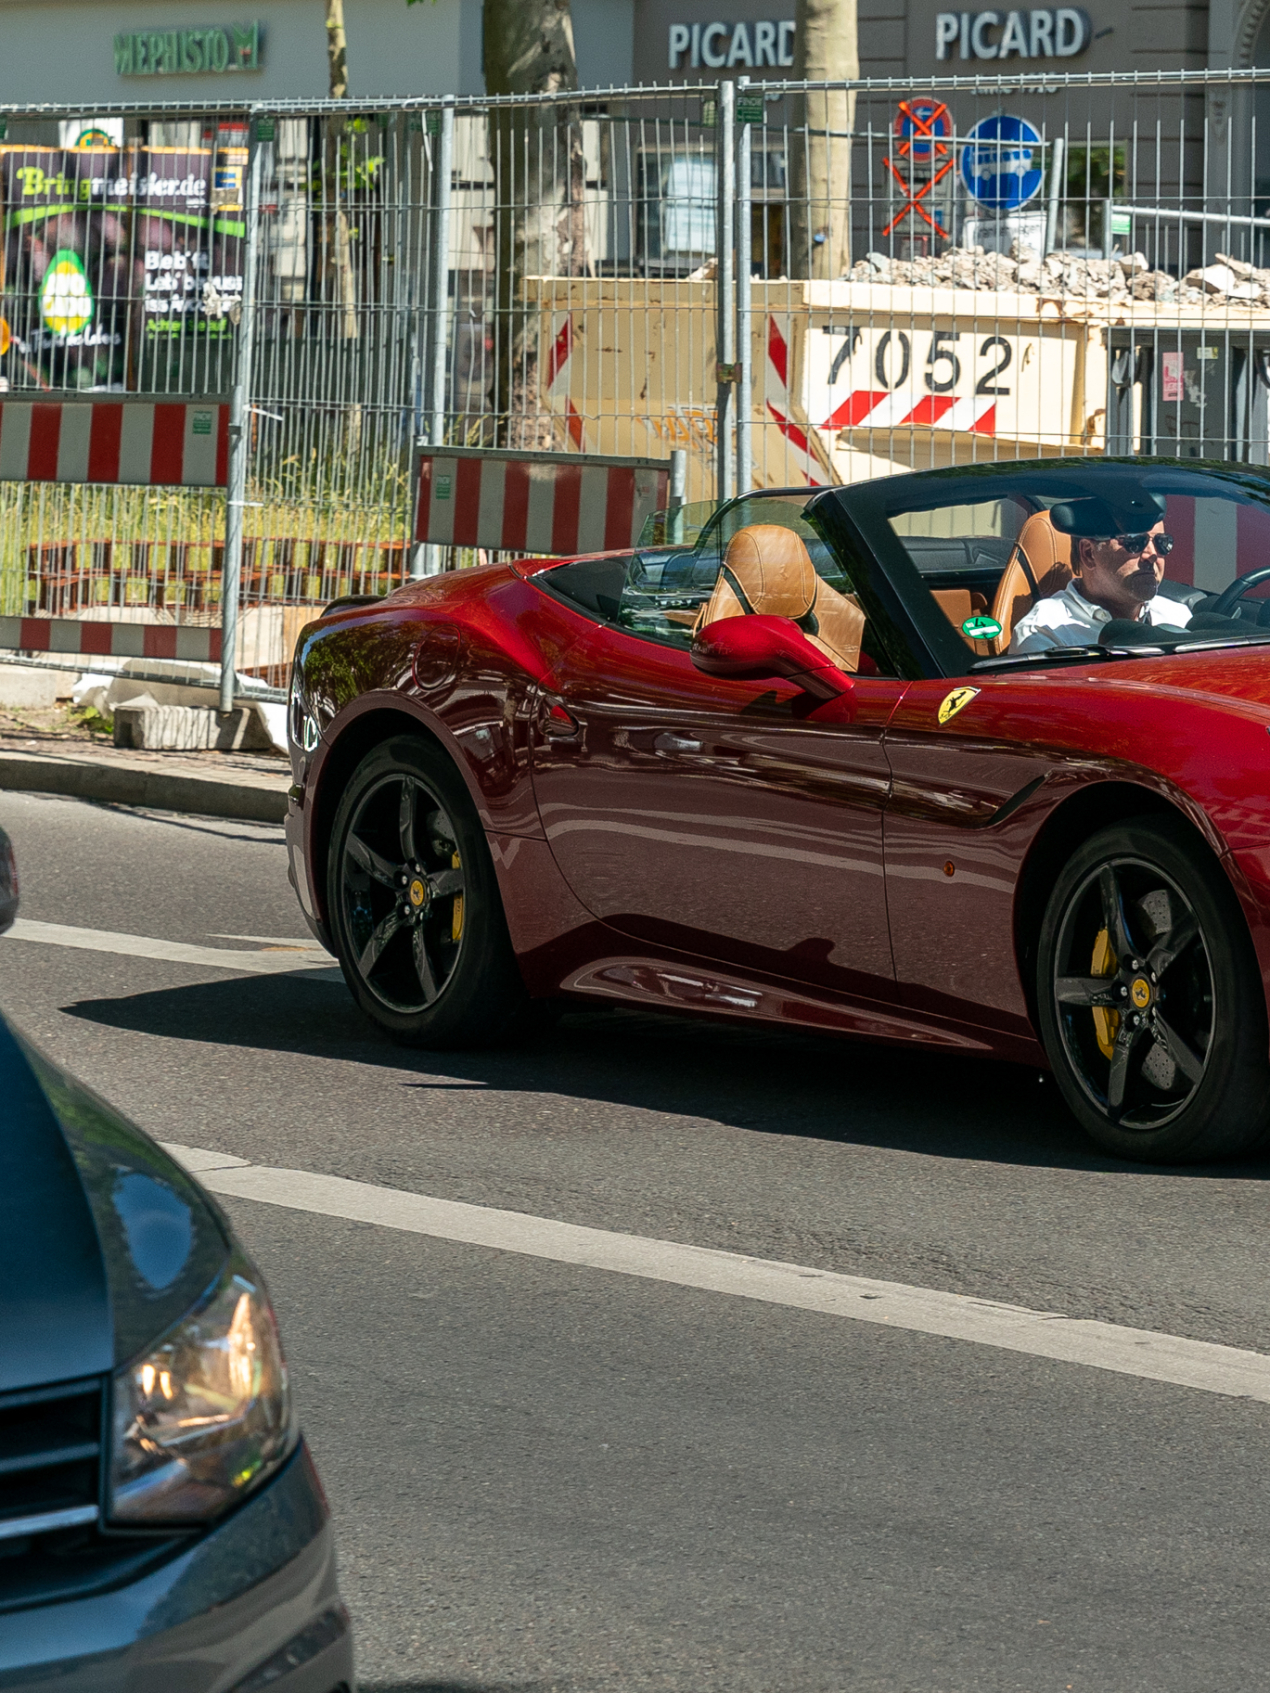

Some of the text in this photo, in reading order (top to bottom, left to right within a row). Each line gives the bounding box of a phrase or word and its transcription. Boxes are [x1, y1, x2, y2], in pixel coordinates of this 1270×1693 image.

[113, 30, 229, 75] MEPHISTO
[668, 20, 796, 69] PICARD
[935, 8, 1085, 60] PICARD
[822, 325, 1013, 396] 7052
